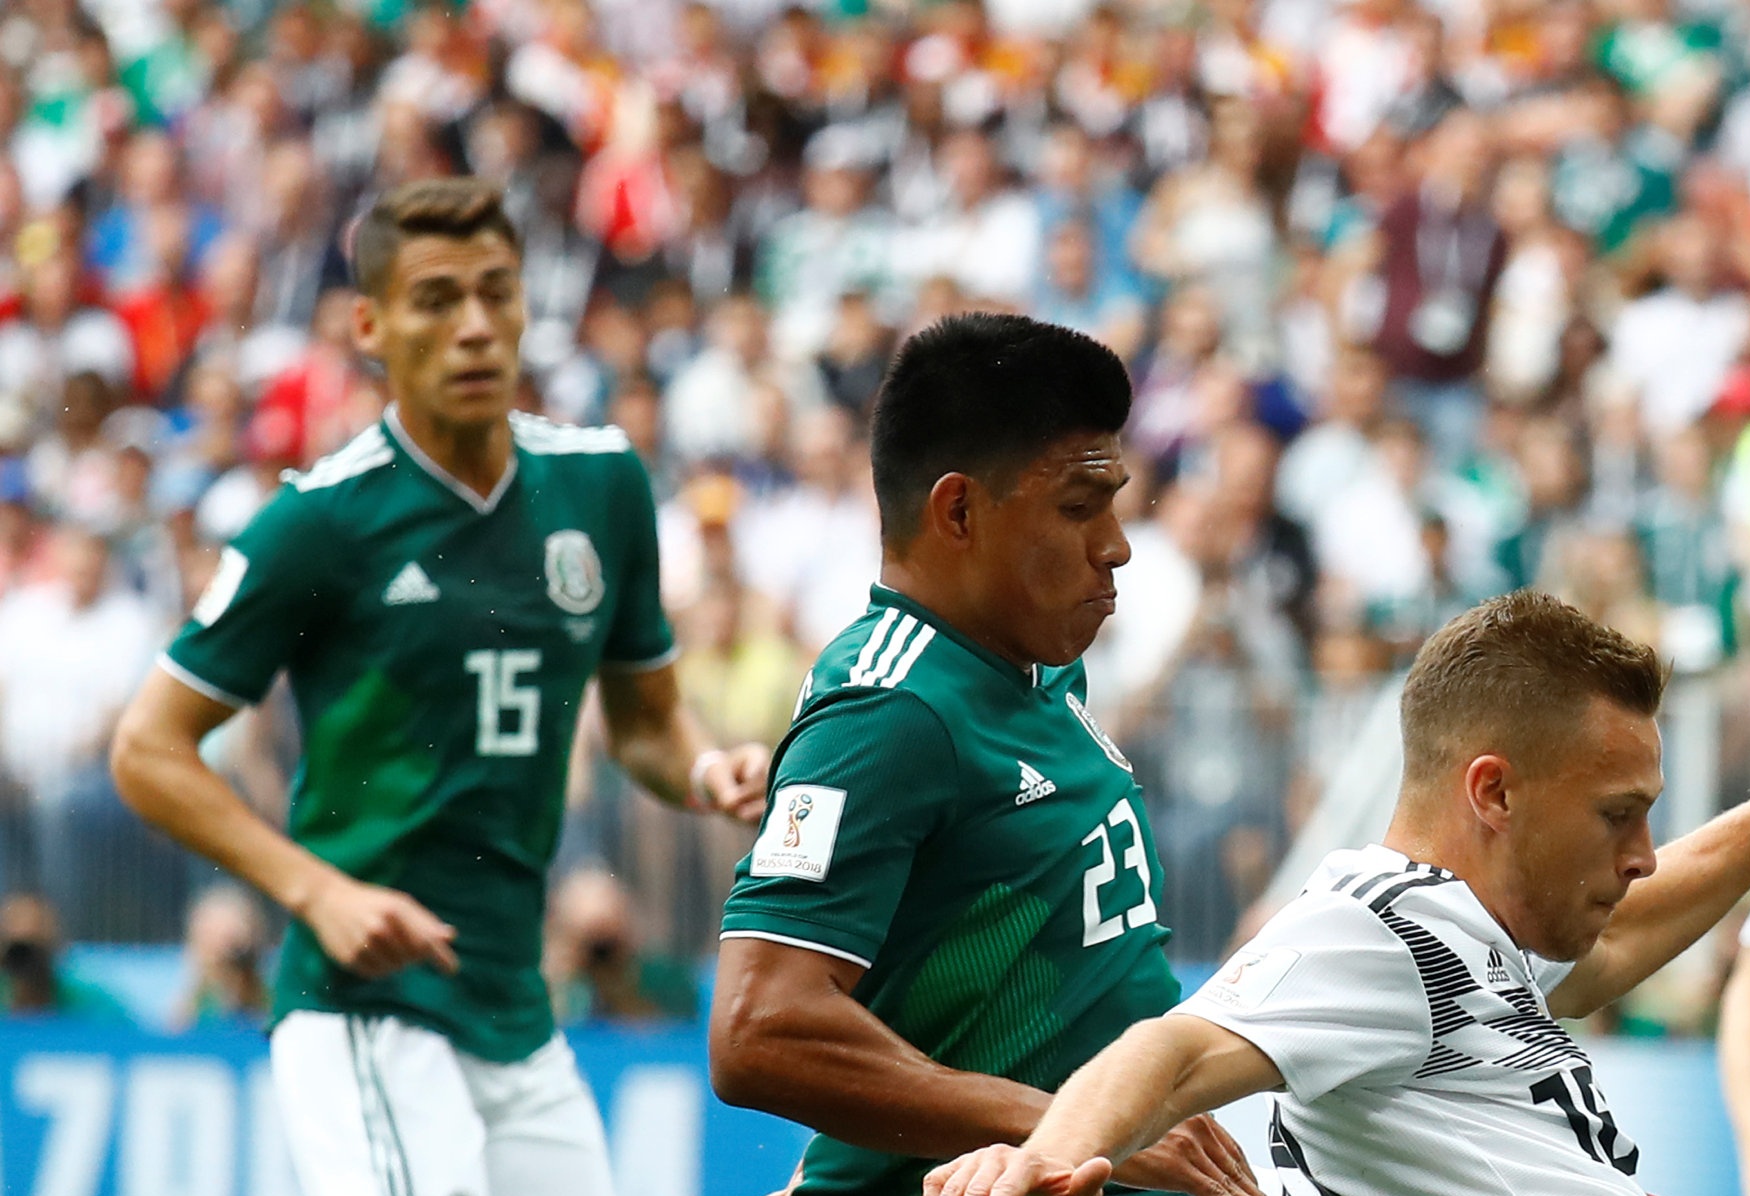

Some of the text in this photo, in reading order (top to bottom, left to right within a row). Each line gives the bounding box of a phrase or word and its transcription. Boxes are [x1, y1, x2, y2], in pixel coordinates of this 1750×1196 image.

[463, 648, 542, 756] 15
[1015, 780, 1056, 806] adidas
[794, 859, 823, 874] 2018
[1082, 797, 1158, 948] 23
